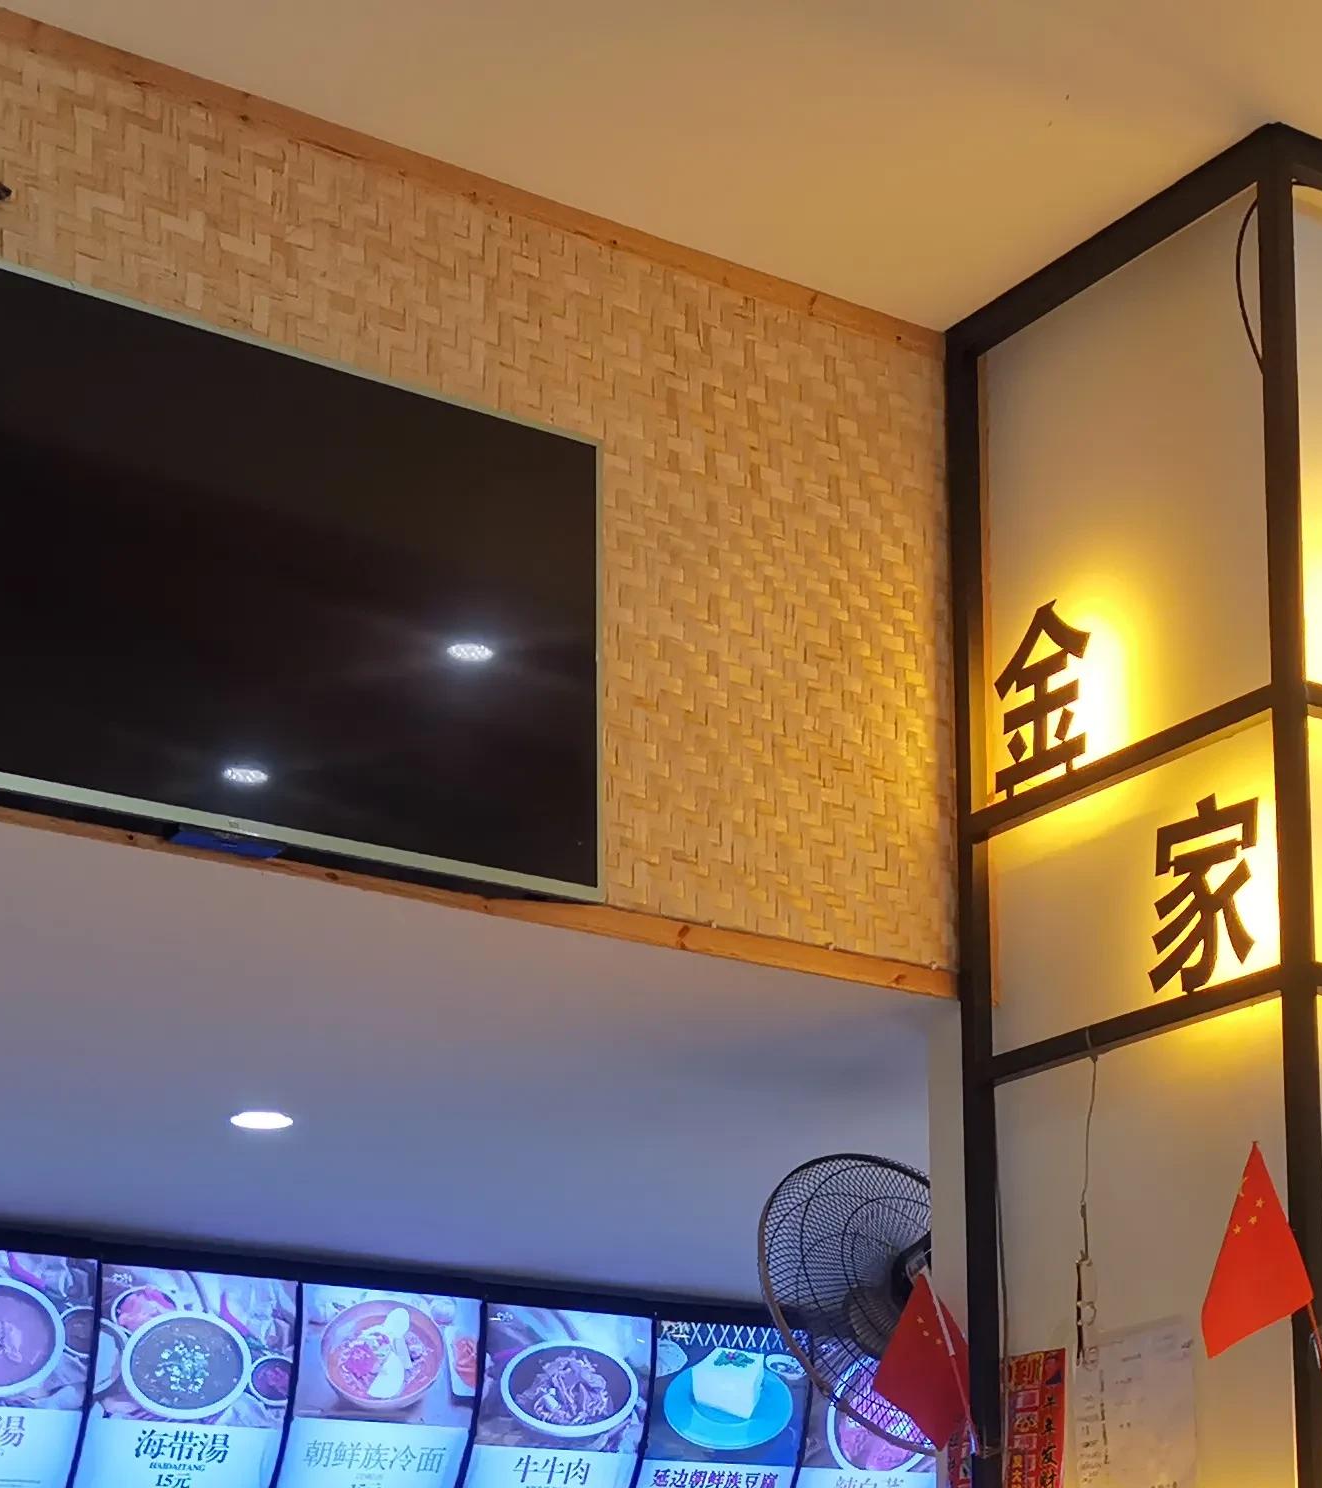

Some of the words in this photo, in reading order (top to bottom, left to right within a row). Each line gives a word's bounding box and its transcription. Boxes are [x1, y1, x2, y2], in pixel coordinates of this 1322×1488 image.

[995, 598, 1091, 801] 金
[1148, 793, 1259, 996] 家
[303, 1440, 448, 1474] 朝鲜族冷面
[512, 1454, 592, 1486] 牛牛肉
